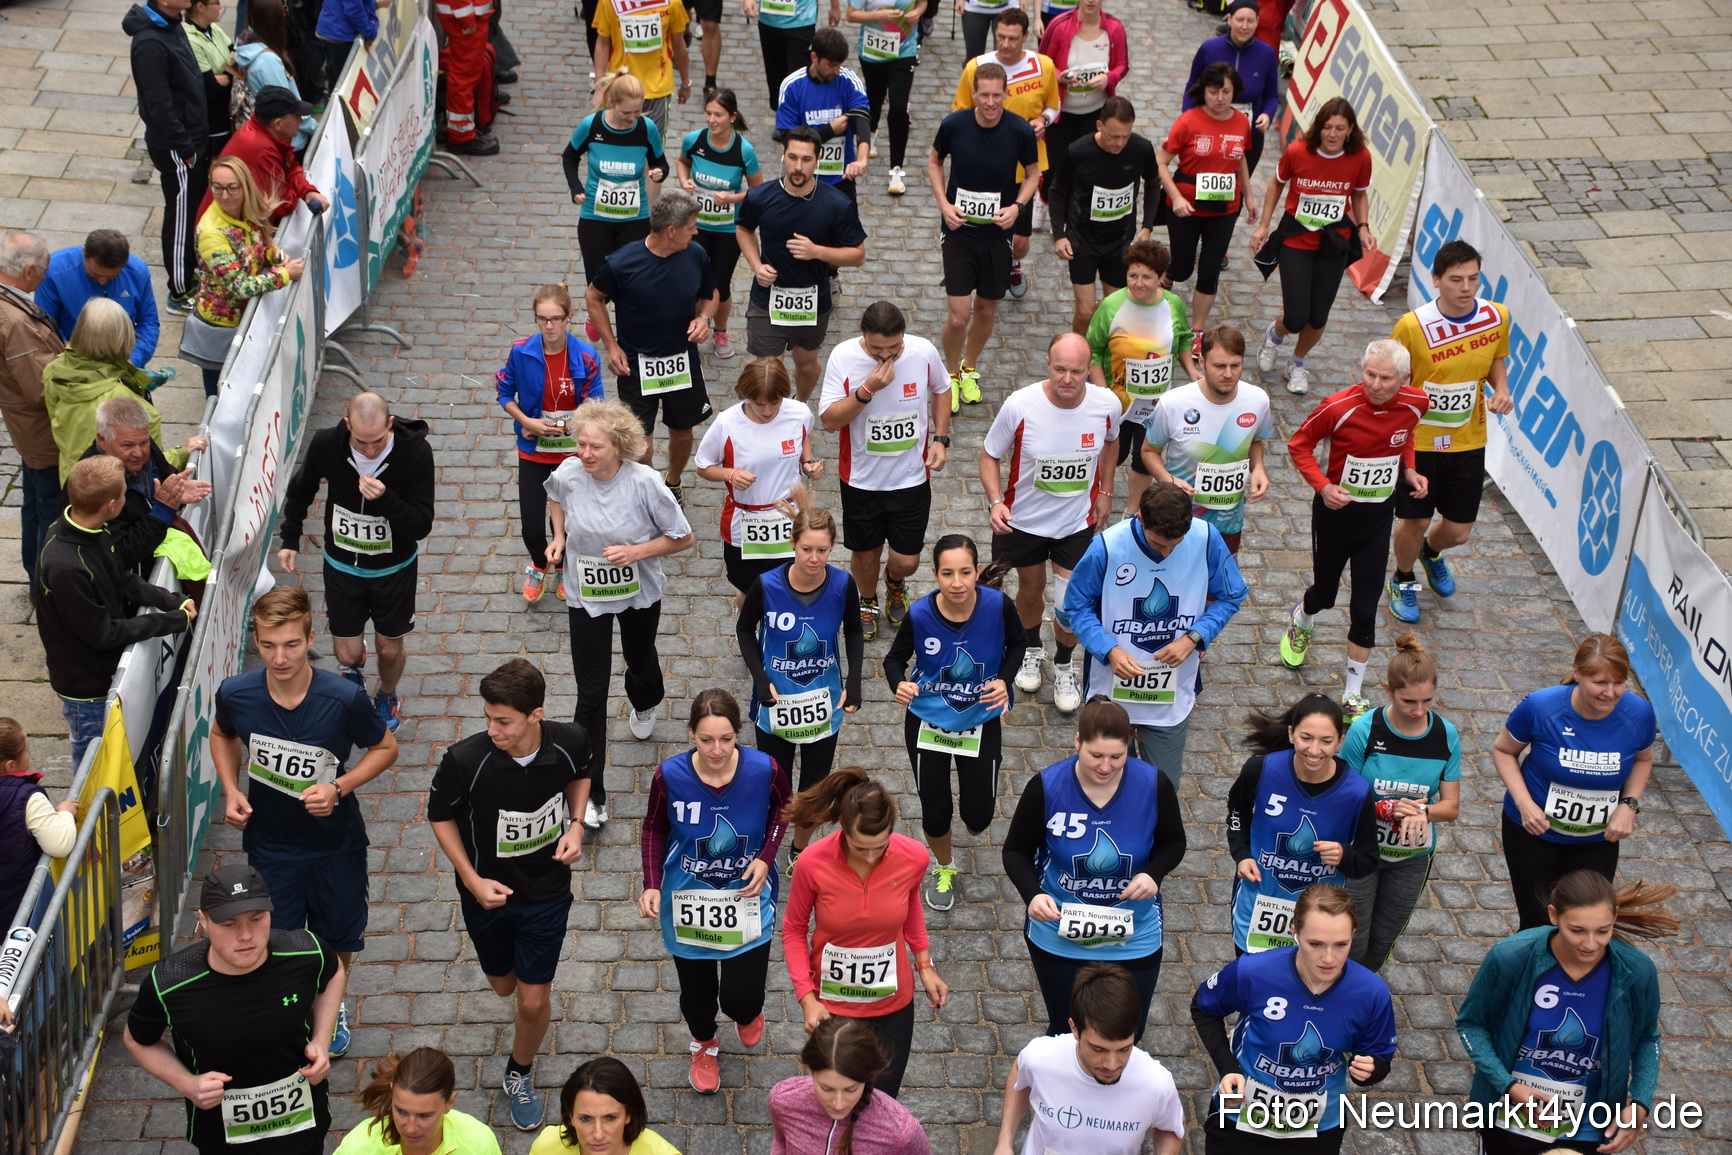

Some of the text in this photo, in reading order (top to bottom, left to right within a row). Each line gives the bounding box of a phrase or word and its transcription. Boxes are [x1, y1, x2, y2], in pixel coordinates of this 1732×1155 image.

[625, 23, 658, 38] 5176
[867, 34, 895, 52] 5121
[1016, 81, 1044, 96] BÖGL
[805, 108, 842, 121] HUBER
[600, 160, 636, 170] HUBER
[696, 172, 730, 188] HUBER
[1202, 176, 1233, 190] 5063
[1297, 178, 1344, 190] NEUMARKT
[600, 190, 636, 206] 5037
[1096, 192, 1130, 209] 5125
[960, 200, 996, 218] 5304
[1302, 201, 1340, 219] 5043
[774, 294, 814, 310] 5035
[779, 312, 807, 320] Christian
[1431, 331, 1502, 363] MAX BÖGL
[645, 356, 686, 377] 5036
[1131, 366, 1168, 384] 5132
[658, 379, 674, 387] Willi
[1429, 394, 1472, 411] 5323
[871, 422, 915, 441] 5303
[1040, 464, 1086, 480] 5305
[1198, 466, 1241, 474] PARTL Neumarkt
[1367, 460, 1392, 468] Neumarkt
[1201, 472, 1244, 492] 5058
[1348, 468, 1392, 486] 5123
[1209, 496, 1234, 504] Philipp
[1358, 489, 1376, 497] Horst
[338, 518, 386, 540] 5119
[748, 522, 792, 542] 5315
[344, 540, 381, 550] Alexander
[584, 566, 634, 584] 5009
[1116, 563, 1138, 586] 9
[592, 587, 630, 596] Katharina
[766, 612, 796, 630] 10
[1113, 616, 1194, 634] FIBALON
[924, 637, 942, 656] 9
[1137, 634, 1171, 642] BASKETS
[771, 656, 835, 671] FIBALON
[792, 668, 819, 678] BASKETS
[1623, 588, 1647, 628] AUF
[1644, 619, 1674, 680] JEDER
[1669, 668, 1718, 757] STRECKE
[792, 696, 820, 705] Neumarkt
[948, 694, 976, 702] BASKETS
[1130, 692, 1158, 700] Philipp
[776, 702, 828, 726] 5055
[252, 738, 312, 756] PARTL Neumarkt
[934, 736, 963, 747] Cinthya
[256, 748, 316, 778] 5165
[1558, 747, 1621, 765] HUBER
[268, 774, 294, 790] Jonas
[1374, 778, 1430, 794] HUBER
[1551, 788, 1608, 802] PARTL Neumarkt
[500, 804, 553, 822] PARTL Neumarkt
[672, 800, 702, 824] 11
[1264, 793, 1288, 816] 5
[1552, 798, 1609, 824] 5011
[506, 808, 556, 840] 5171
[1046, 812, 1088, 838] 45
[514, 832, 552, 851] Christian
[1260, 850, 1336, 876] FIBALON
[1278, 873, 1312, 882] BASKETS
[1257, 900, 1280, 911] PARTL
[680, 904, 738, 928] 5138
[1062, 909, 1122, 921] PARTL Neumarkt
[696, 932, 722, 942] Nicole
[1268, 938, 1294, 948] Maria
[824, 950, 885, 960] PARTL Neumarkt
[830, 960, 890, 984] 5157
[840, 986, 877, 996] Claudia
[1534, 984, 1560, 1009] 6
[1263, 996, 1288, 1020] 8
[1258, 1058, 1344, 1078] FIBALON
[1541, 1060, 1581, 1075] BASKETS
[224, 1082, 295, 1102] PARTL Neumarkt
[1532, 1082, 1570, 1096] Neumarkt
[233, 1088, 304, 1122] 5052
[250, 1117, 291, 1133] Markus
[1038, 1102, 1140, 1131] FeG NEUMARKT
